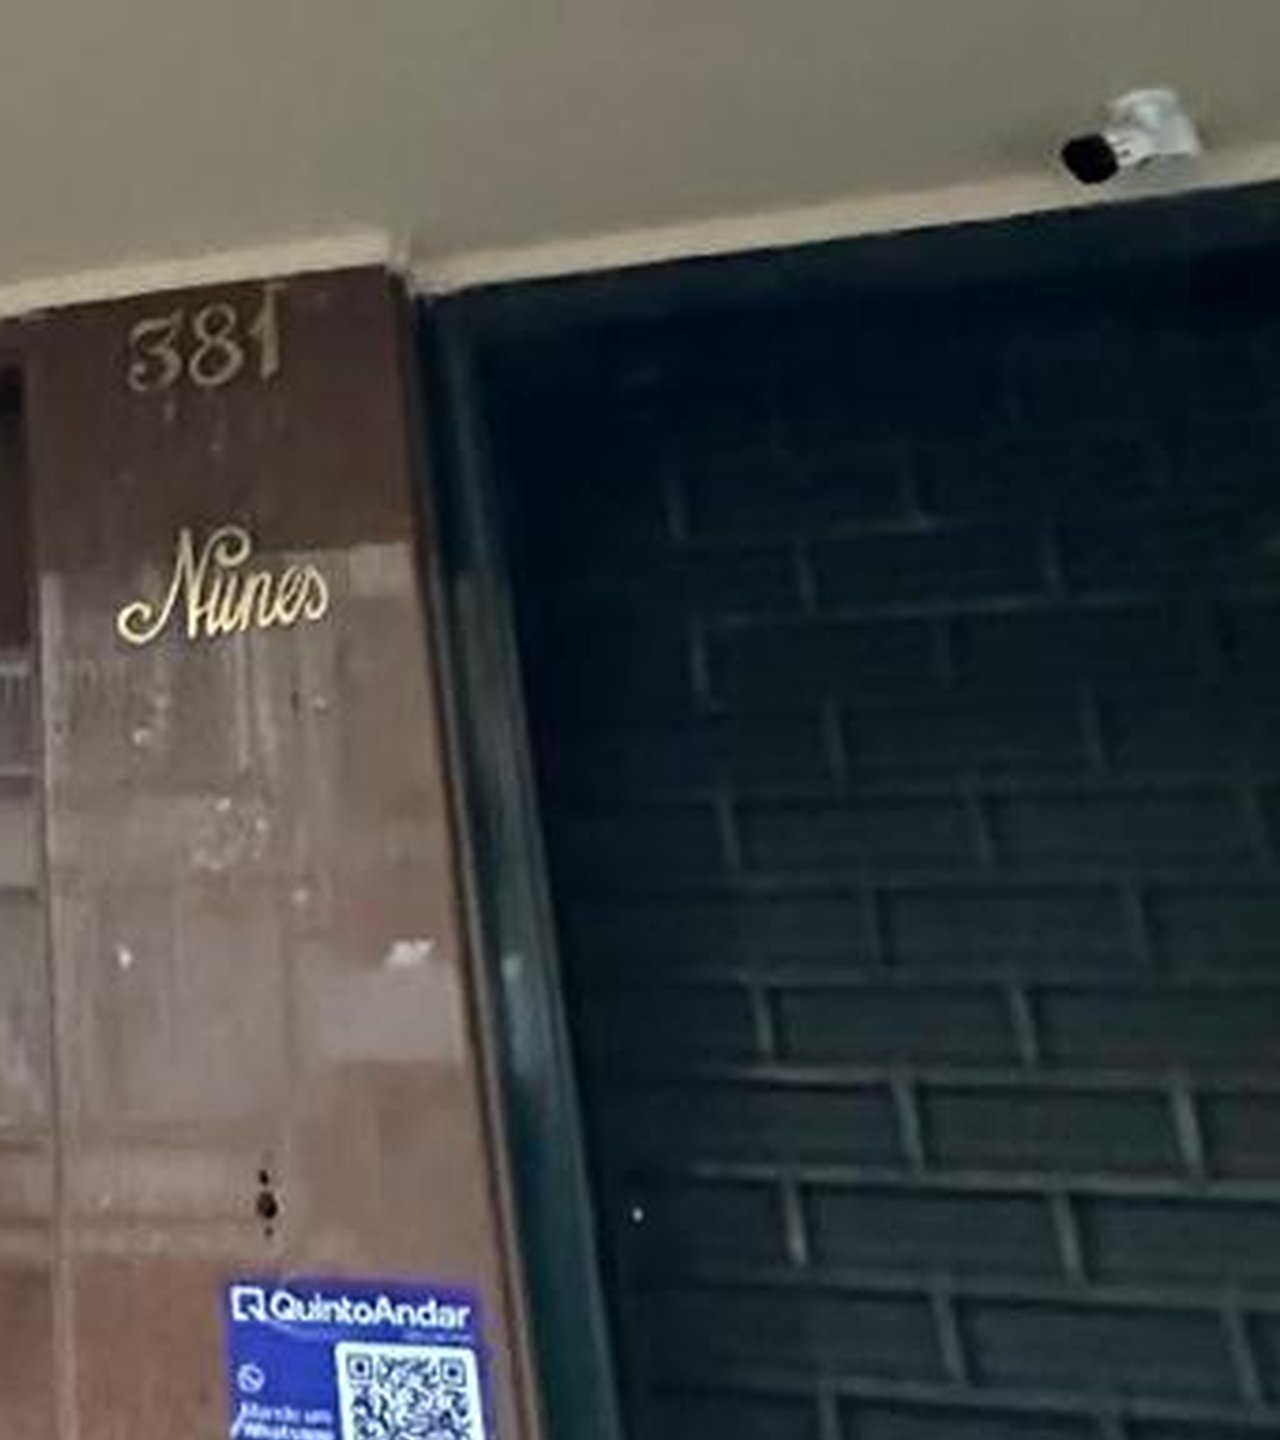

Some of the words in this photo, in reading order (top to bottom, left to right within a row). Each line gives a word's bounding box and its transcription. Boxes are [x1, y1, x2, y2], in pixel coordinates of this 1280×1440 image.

[127, 283, 288, 391] 381
[118, 525, 329, 644] Nunes
[269, 1289, 471, 1330] QuintoAndar
